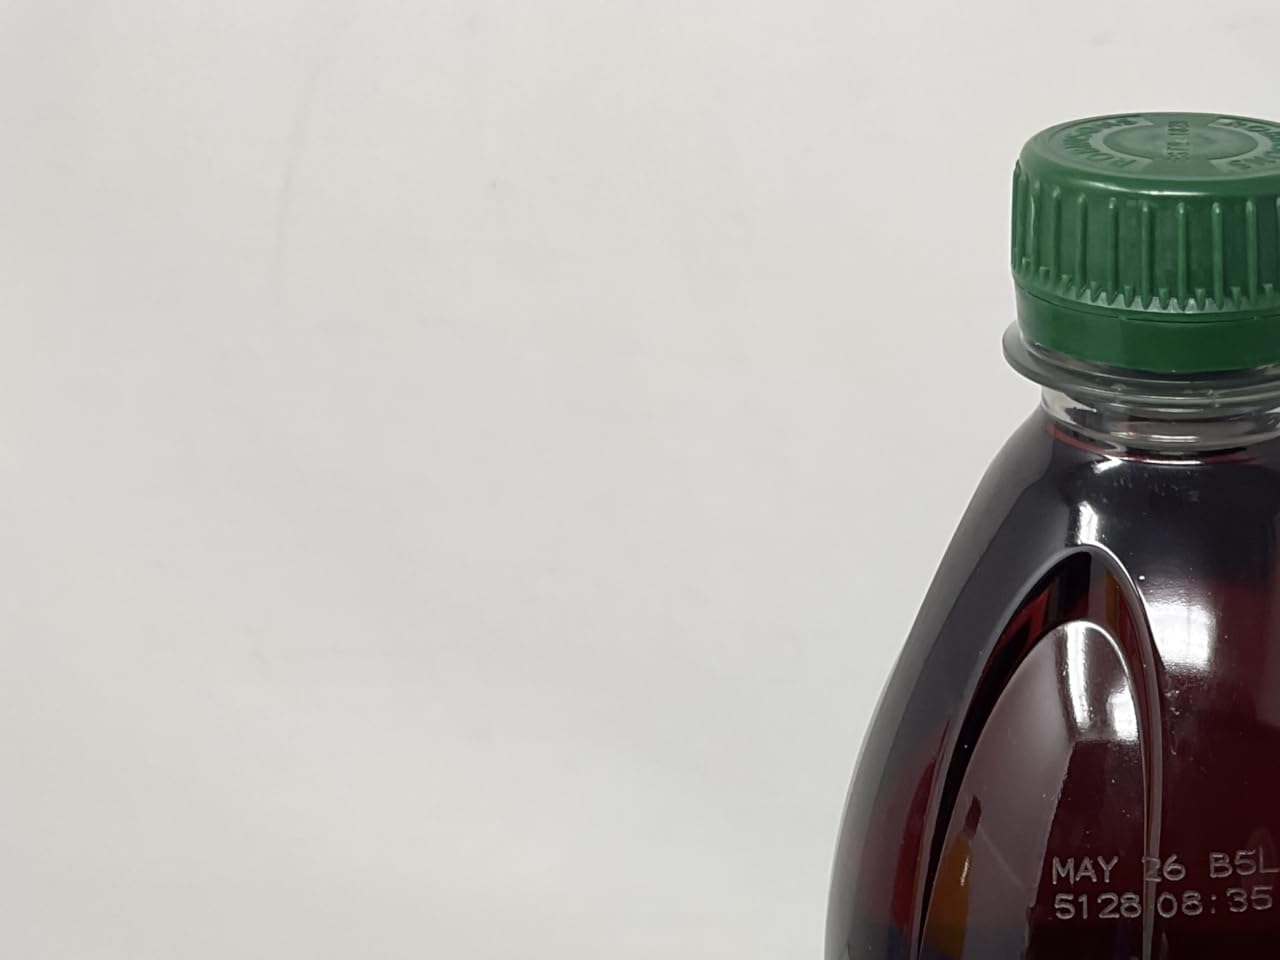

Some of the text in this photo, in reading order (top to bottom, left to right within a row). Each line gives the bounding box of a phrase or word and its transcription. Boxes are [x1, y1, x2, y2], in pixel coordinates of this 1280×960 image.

[1052, 847, 1280, 885] MAY 26 B5L
[1054, 885, 1273, 920] 5128 08:35
